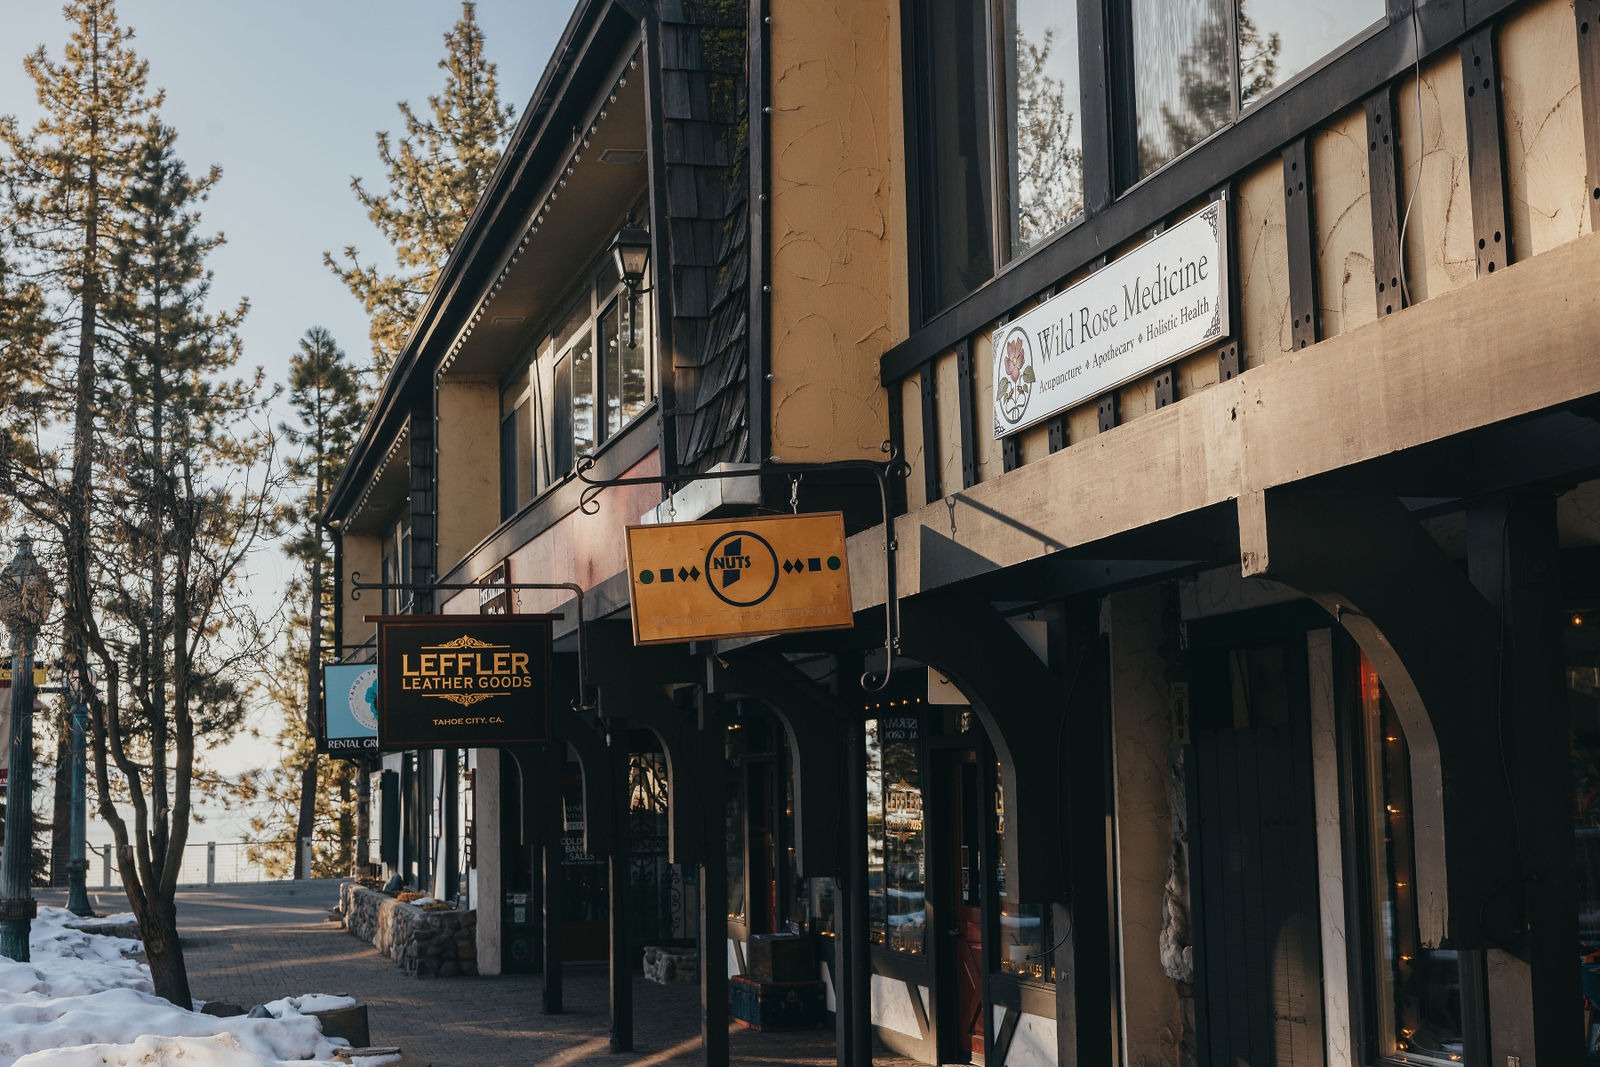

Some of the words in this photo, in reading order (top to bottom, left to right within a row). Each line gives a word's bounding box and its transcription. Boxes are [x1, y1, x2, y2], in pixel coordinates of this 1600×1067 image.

[1037, 312, 1074, 365] Wild
[1080, 304, 1118, 344] Rose
[1122, 255, 1209, 321] Medicine
[1039, 363, 1082, 394] Acupuncture
[1092, 336, 1135, 370] Apothecary
[1146, 314, 1178, 342] Holistic
[1180, 297, 1210, 325] Health
[713, 555, 751, 570] NUTS
[402, 652, 530, 676] LEFFLER
[402, 676, 474, 690] LEATHER
[478, 676, 532, 689] GOODS
[433, 717, 464, 726] TAHOE
[489, 716, 505, 724] CA.
[328, 739, 360, 749] RENTAL
[885, 792, 920, 812] LEFFLER
[560, 838, 583, 846] COLD
[565, 845, 583, 853] BAN
